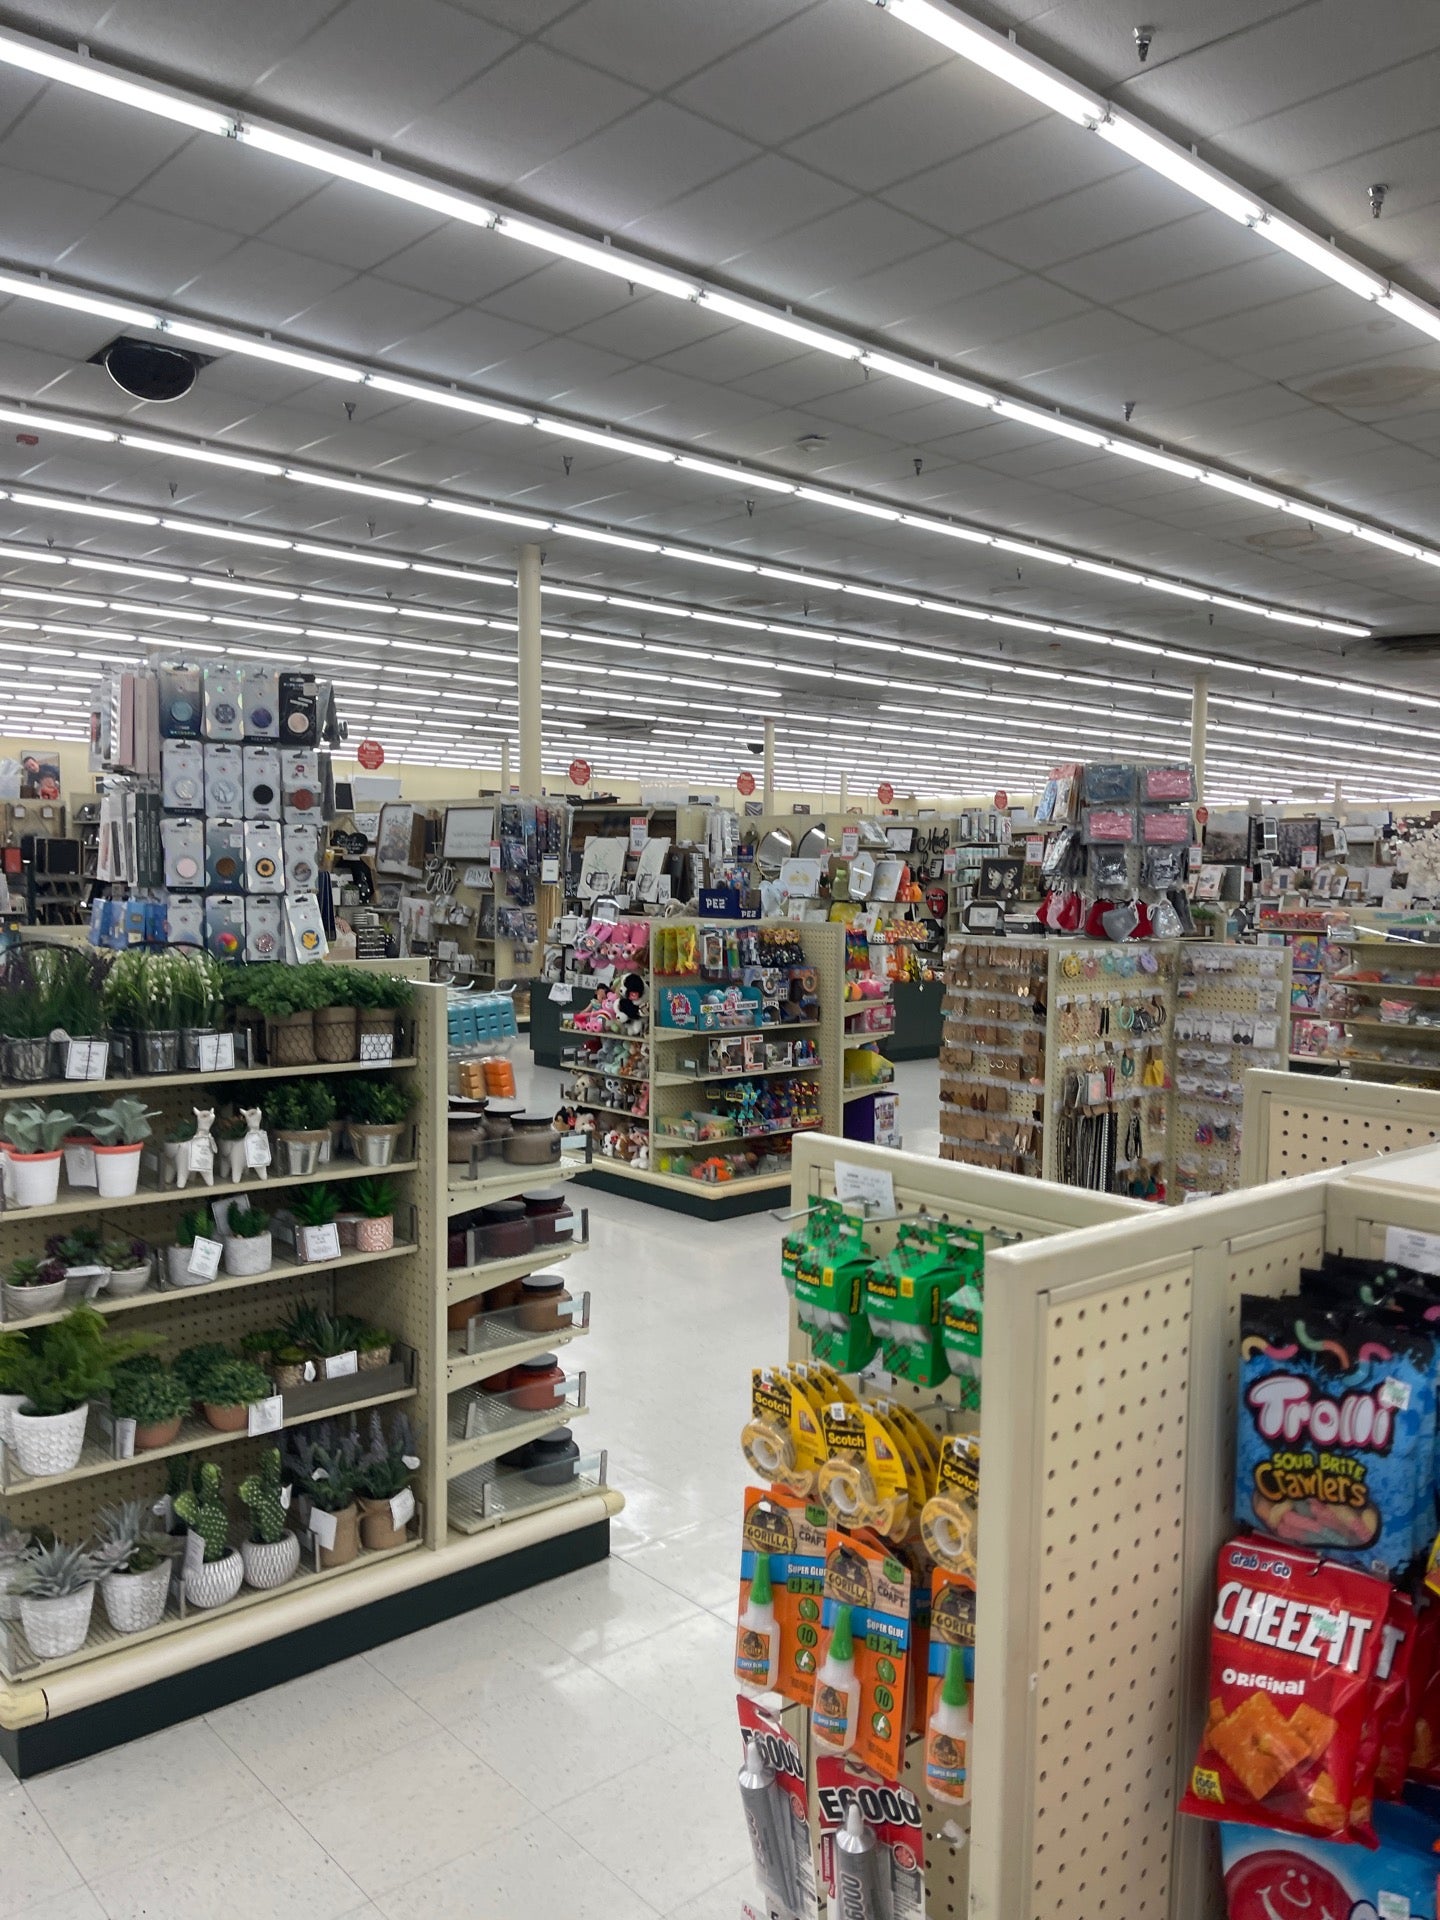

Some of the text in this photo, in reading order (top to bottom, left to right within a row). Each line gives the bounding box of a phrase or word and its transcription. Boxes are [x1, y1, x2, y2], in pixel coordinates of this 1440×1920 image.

[706, 898, 726, 909] PEZ
[741, 910, 757, 918] PEZ
[796, 1270, 821, 1287] Scotch
[867, 1281, 898, 1298] Scotch
[944, 1314, 979, 1334] Scotch
[754, 1391, 790, 1416] Scotch
[1250, 1376, 1396, 1446] Trolli
[828, 1431, 865, 1449] Scotch
[1272, 1452, 1315, 1470] SOUR
[1254, 1462, 1368, 1507] Crawlers
[747, 1528, 790, 1550] GORILLA
[788, 1564, 811, 1576] SUPER
[1230, 1552, 1259, 1571] Grab
[1272, 1562, 1292, 1579] Go
[828, 1574, 869, 1601] GORILLA
[877, 1585, 906, 1608] CRAFT
[802, 1627, 813, 1644] 10
[866, 1619, 904, 1639] SUPER GLUE
[936, 1615, 976, 1639] GORILL
[877, 1690, 891, 1709] 10
[818, 1786, 923, 1829] E6000
